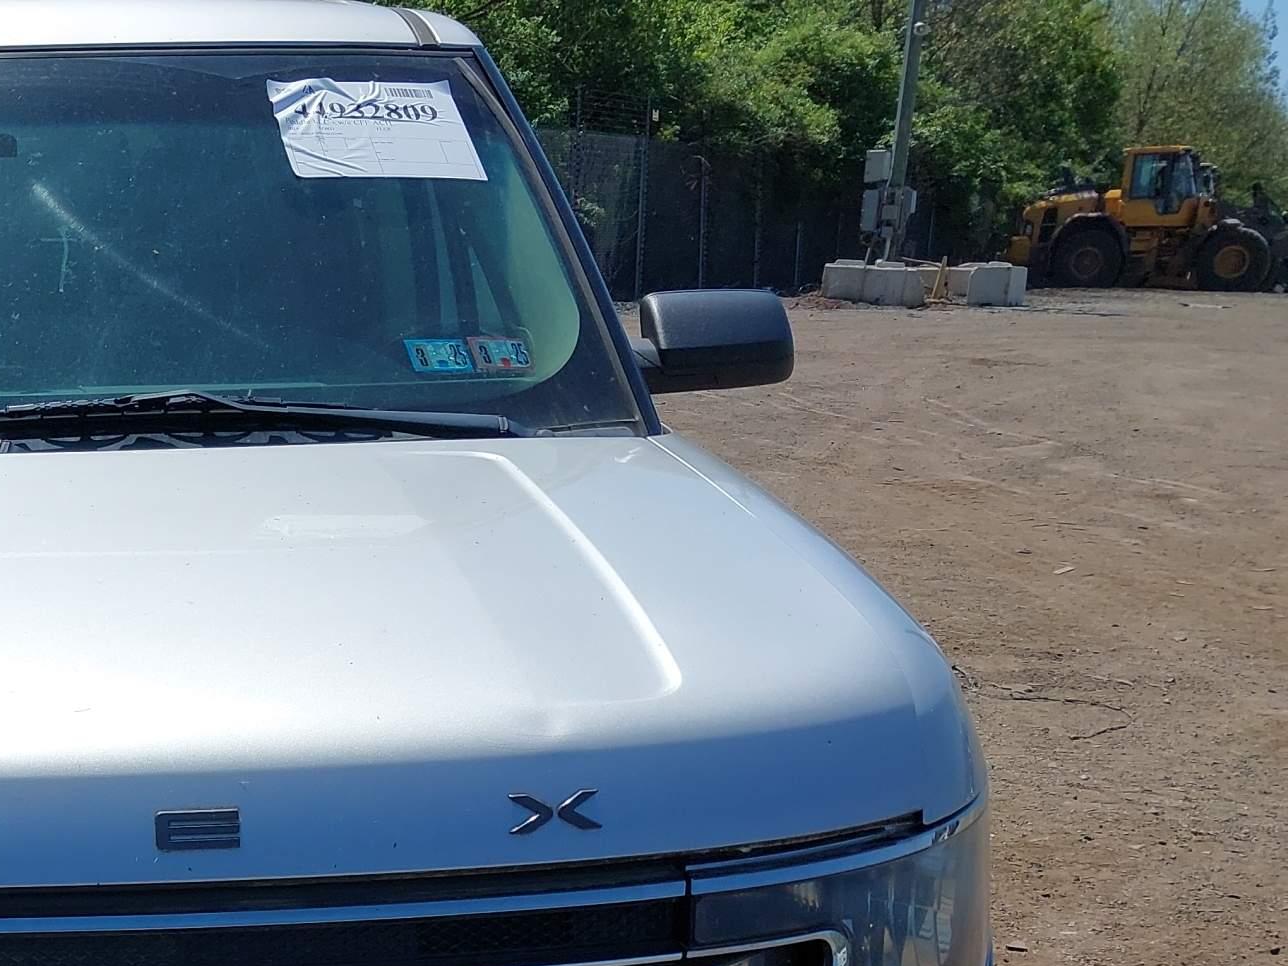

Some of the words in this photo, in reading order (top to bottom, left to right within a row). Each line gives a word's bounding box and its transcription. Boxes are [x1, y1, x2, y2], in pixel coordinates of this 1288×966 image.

[416, 347, 429, 367] 3
[448, 344, 468, 366] 25
[479, 345, 492, 364] 3
[511, 342, 530, 365] 25
